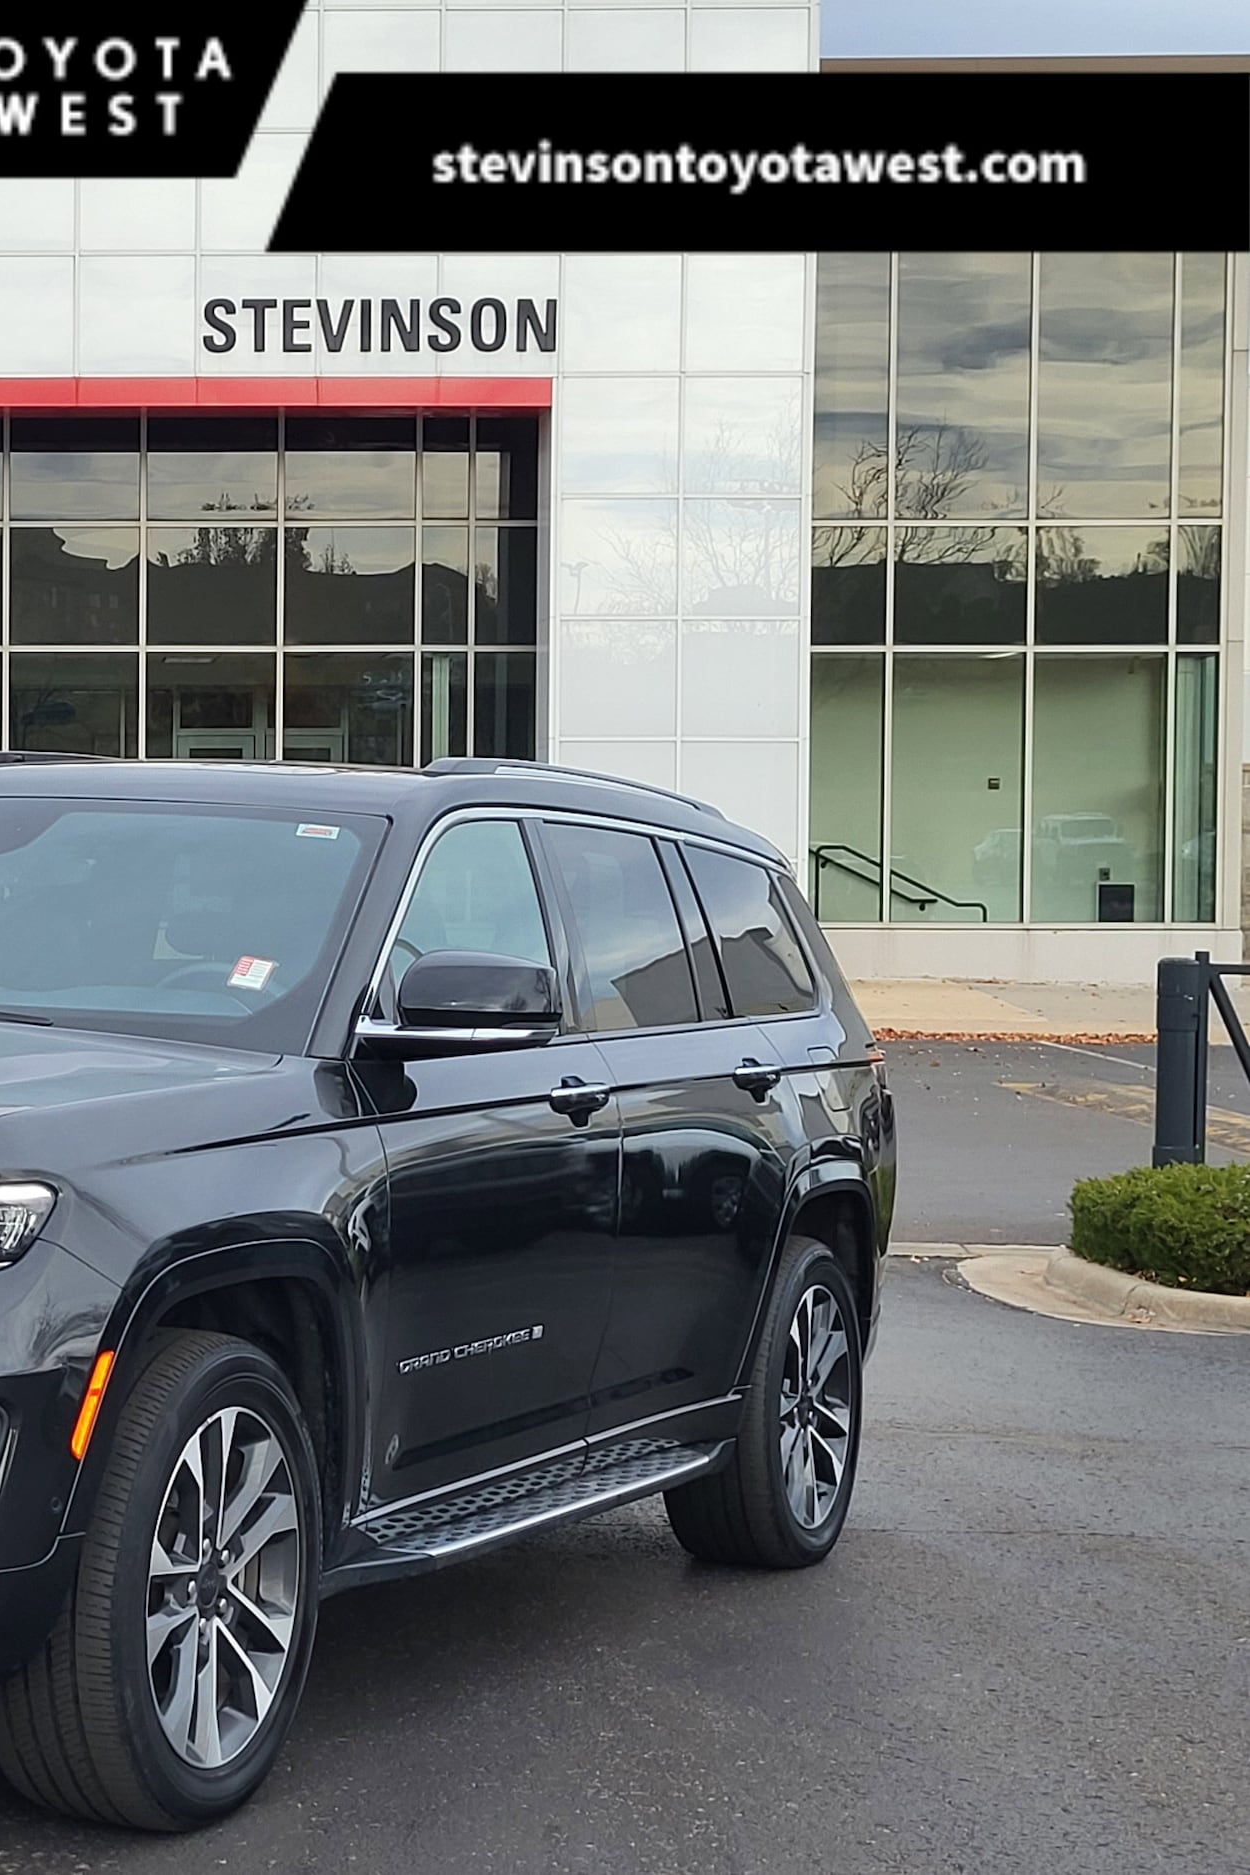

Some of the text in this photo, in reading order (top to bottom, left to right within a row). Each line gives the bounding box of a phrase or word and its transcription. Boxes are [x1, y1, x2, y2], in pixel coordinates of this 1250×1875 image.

[202, 297, 558, 354] STEVINSON
[398, 1349, 451, 1374] GRAND
[453, 1328, 530, 1359] CHEROKEE
